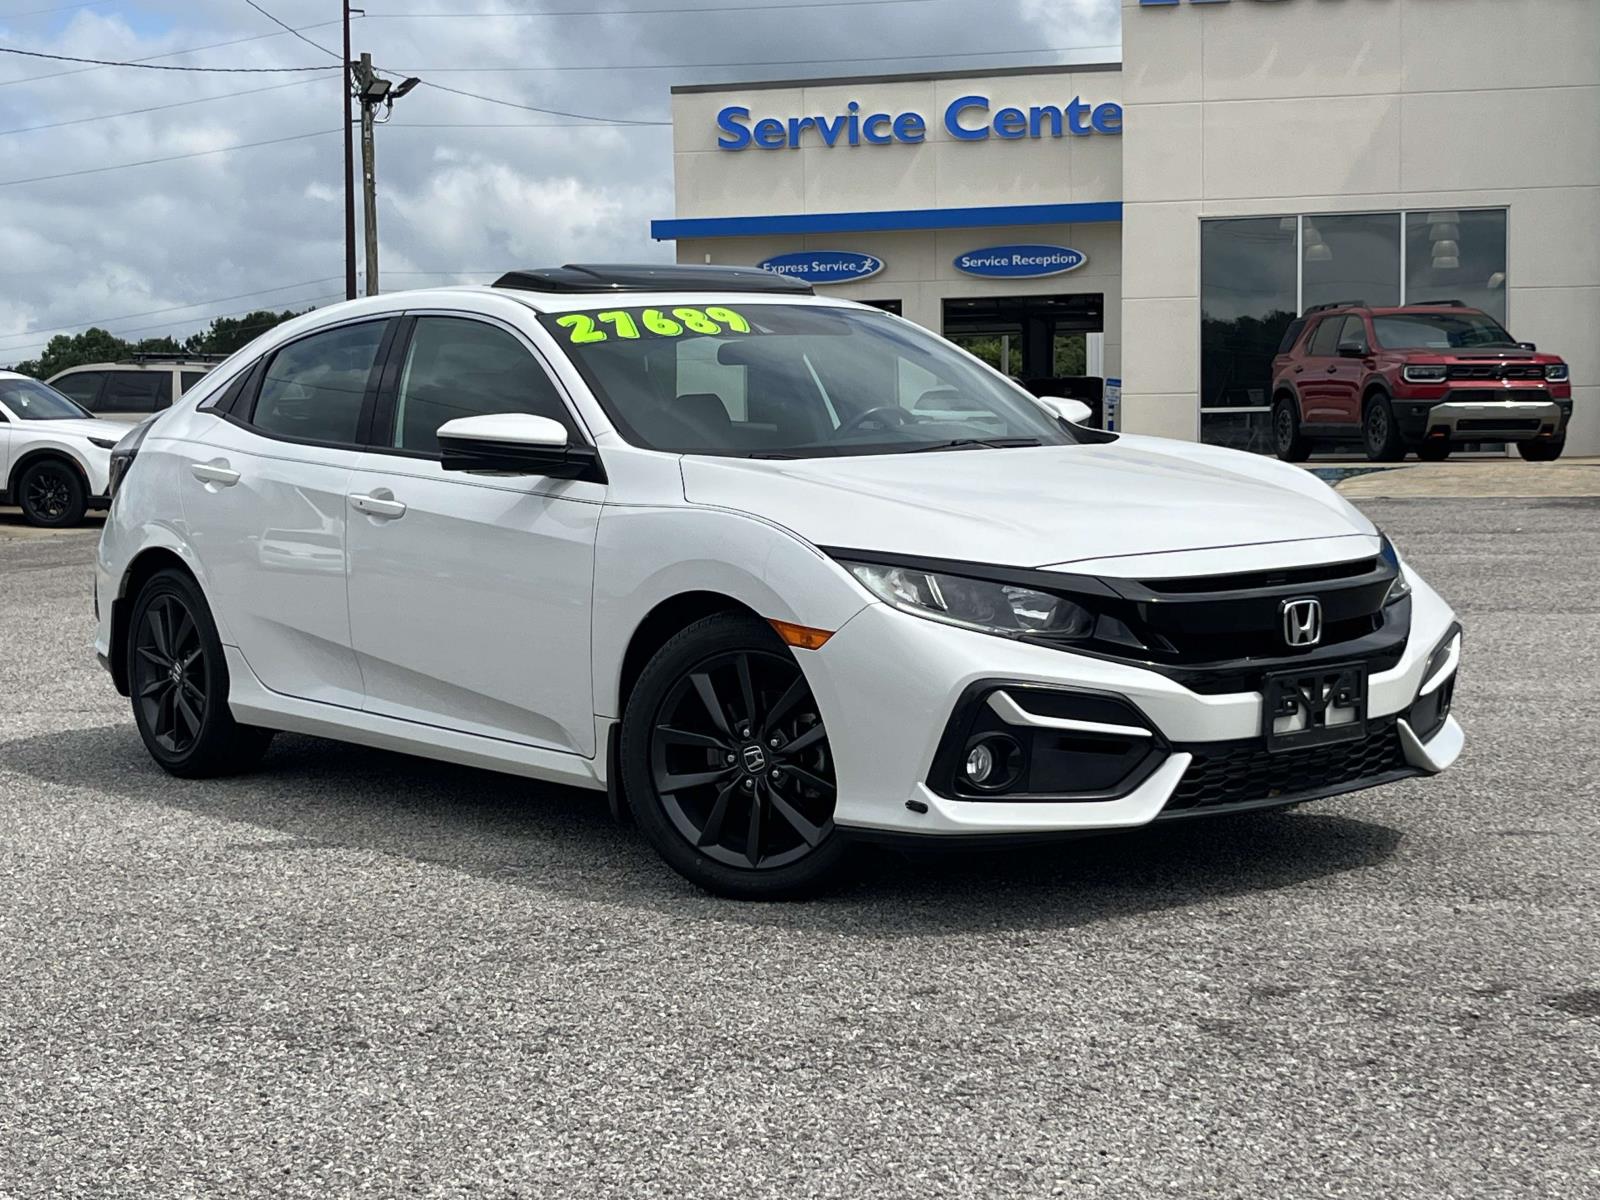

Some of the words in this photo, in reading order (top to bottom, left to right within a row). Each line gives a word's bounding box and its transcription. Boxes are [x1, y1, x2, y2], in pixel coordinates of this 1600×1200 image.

[717, 101, 925, 150] Service
[763, 262, 808, 275] Express
[812, 261, 856, 272] Service
[961, 256, 1009, 268] Service
[1012, 253, 1076, 267] Reception
[556, 307, 750, 343] 27689
